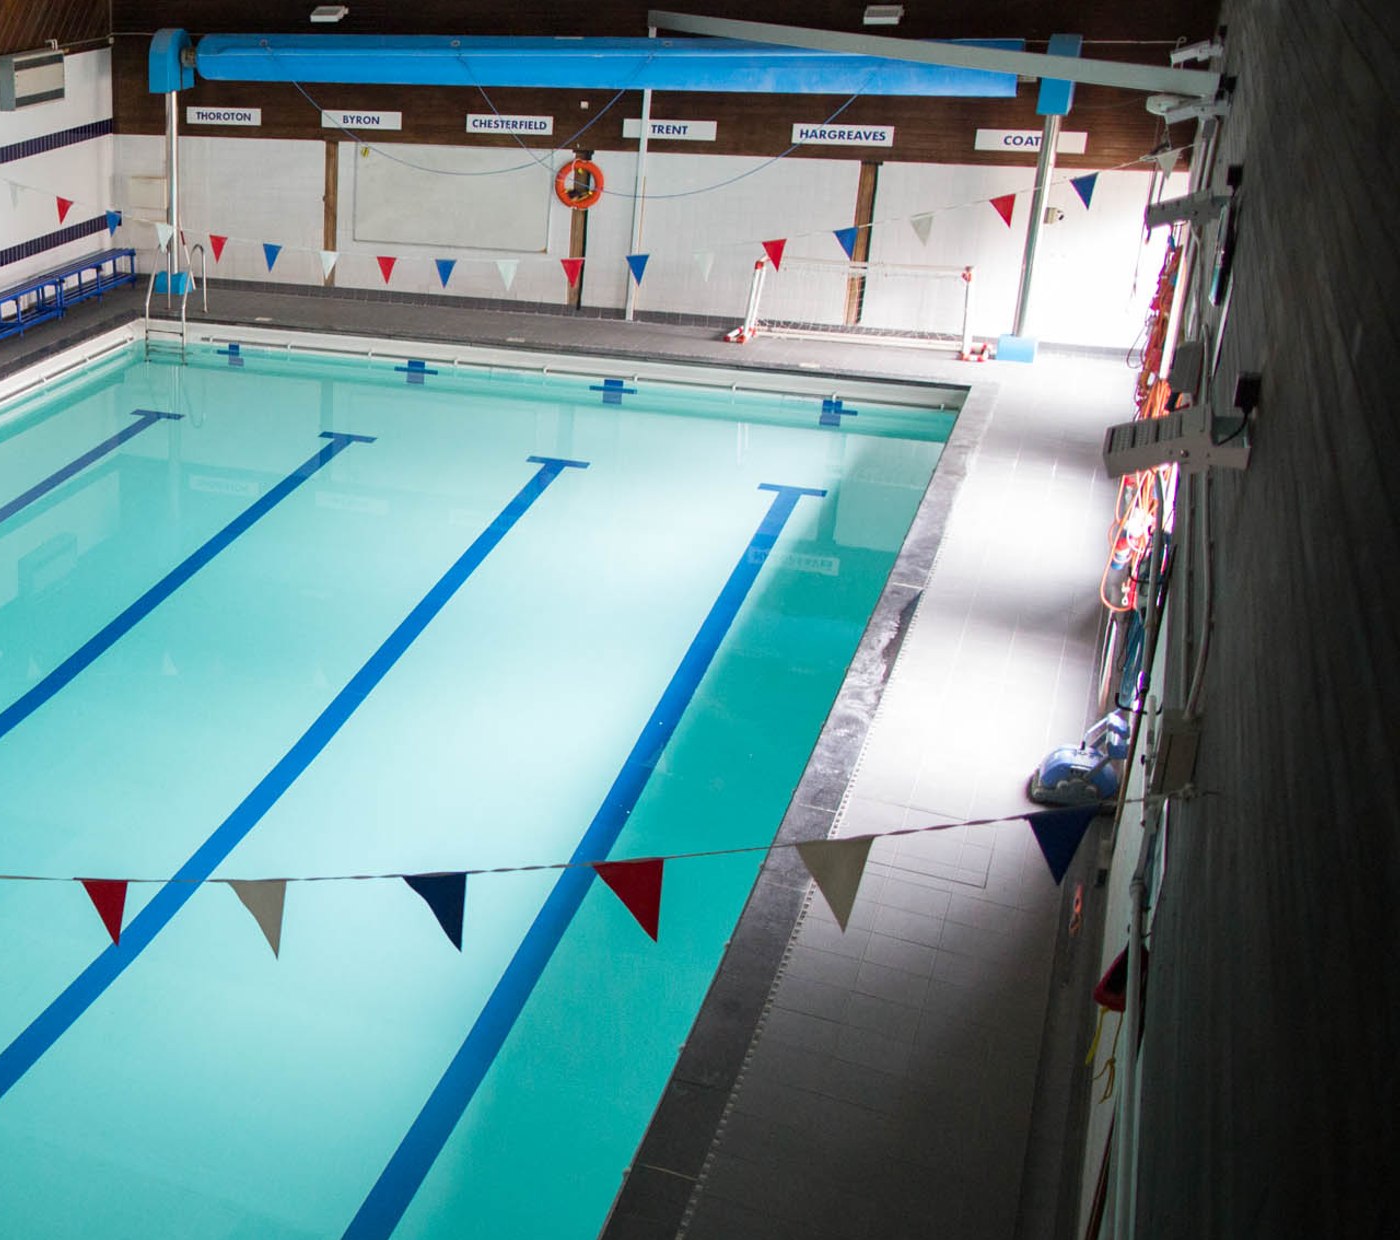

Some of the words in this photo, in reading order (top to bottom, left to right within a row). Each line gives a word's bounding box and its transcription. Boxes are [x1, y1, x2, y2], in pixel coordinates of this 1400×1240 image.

[195, 111, 252, 122] THOROTON
[342, 115, 380, 125] BYRON
[472, 118, 548, 131] CHESTERFIELD
[651, 124, 689, 135] TRENT
[799, 128, 886, 142] HARGREAVES
[1003, 135, 1042, 146] COAT
